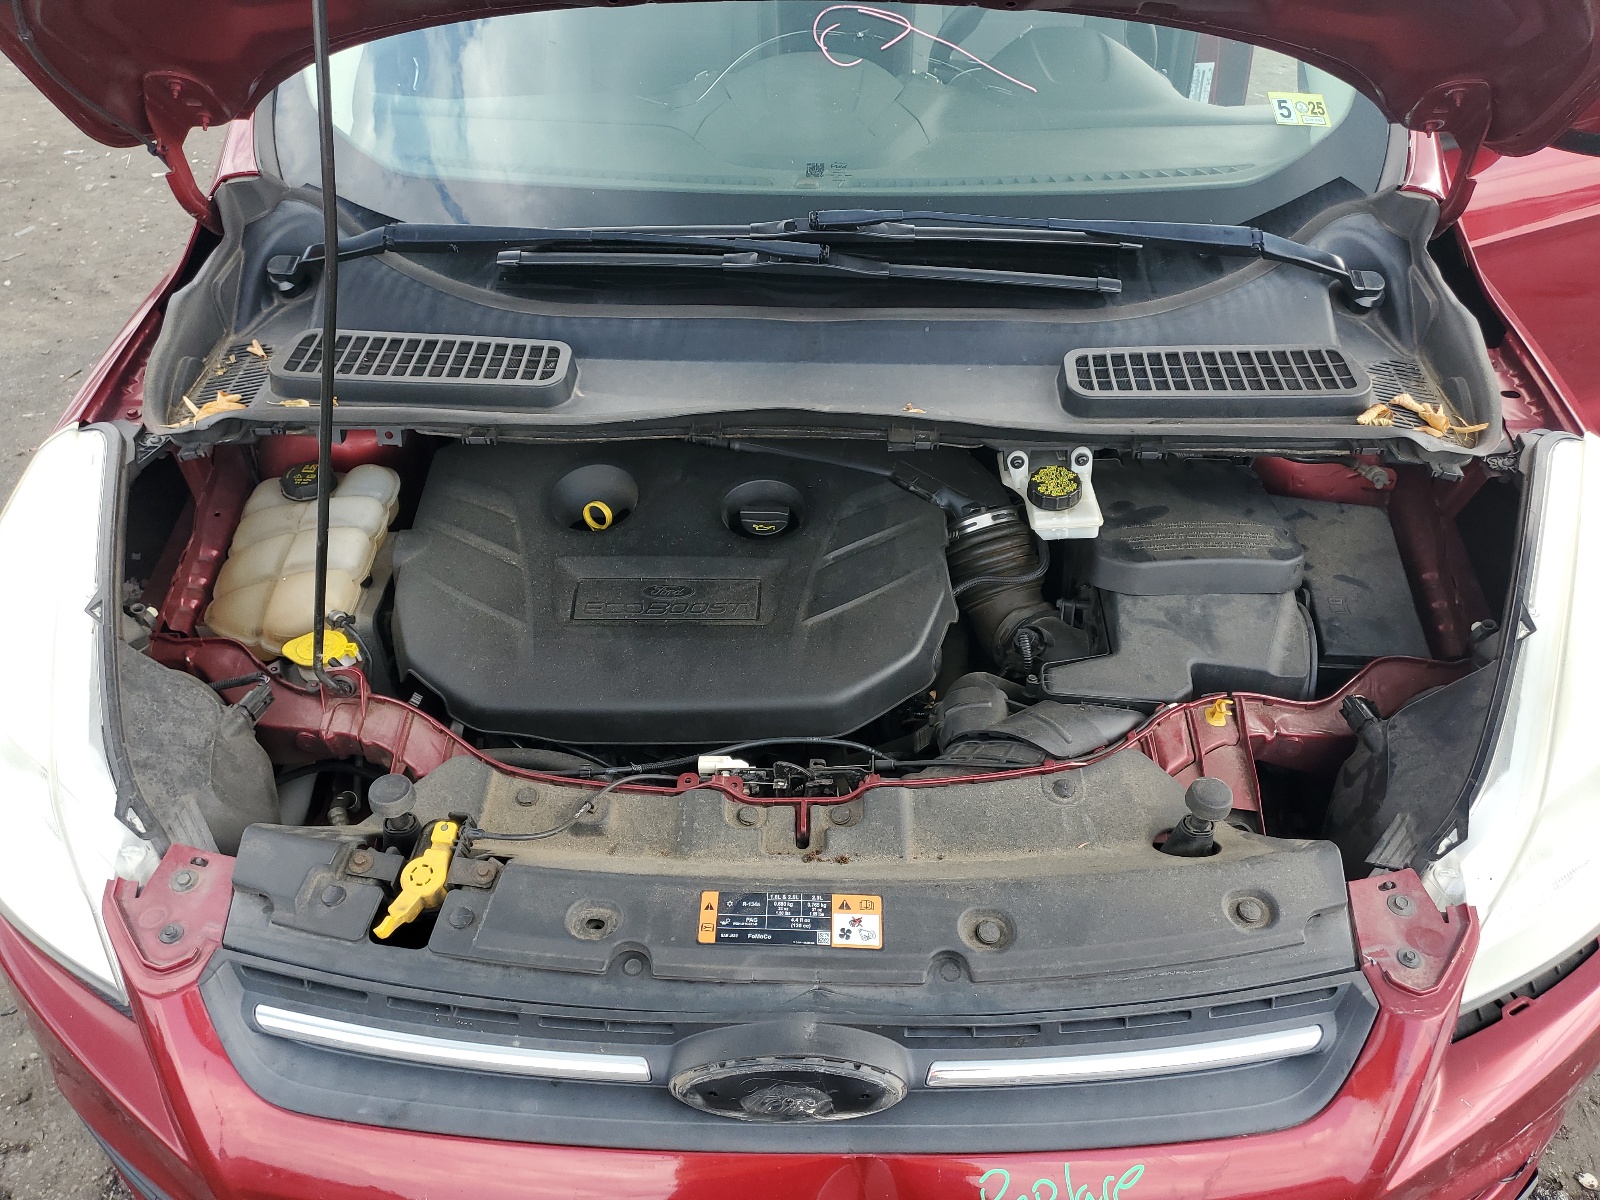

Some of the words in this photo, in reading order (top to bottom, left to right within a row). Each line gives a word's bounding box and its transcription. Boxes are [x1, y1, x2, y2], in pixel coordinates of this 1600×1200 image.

[1277, 99, 1292, 118] 5
[1307, 101, 1326, 116] 25
[650, 584, 685, 597] Ford
